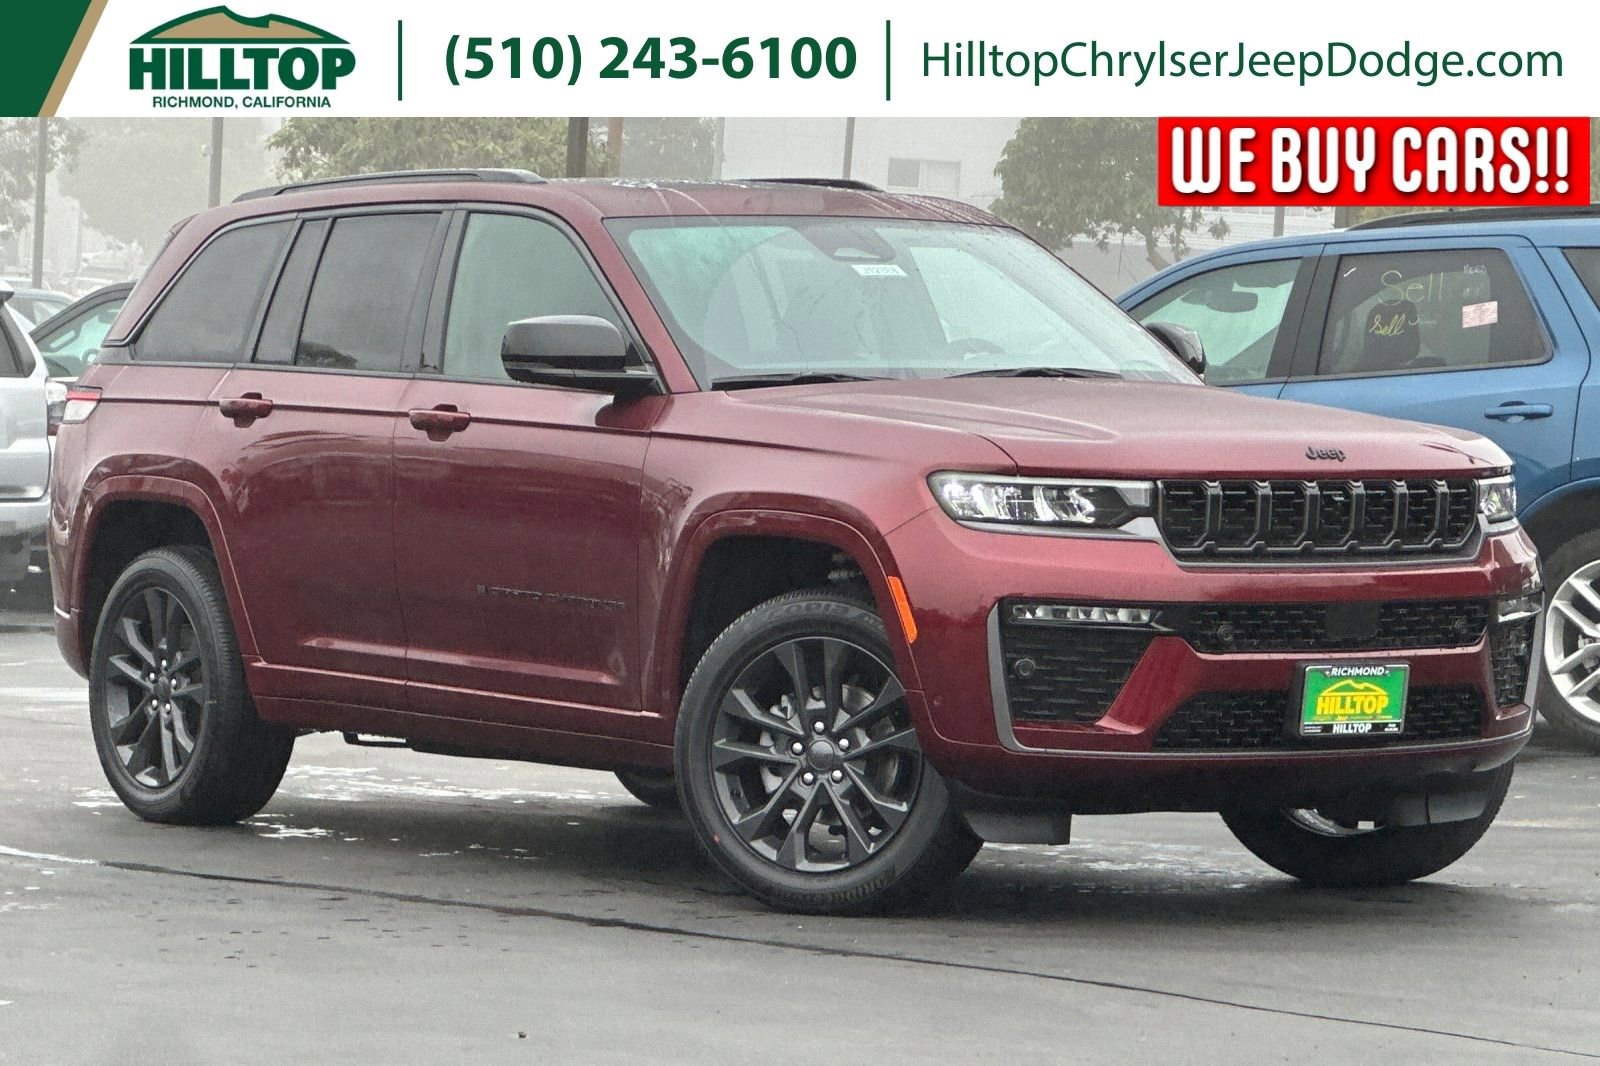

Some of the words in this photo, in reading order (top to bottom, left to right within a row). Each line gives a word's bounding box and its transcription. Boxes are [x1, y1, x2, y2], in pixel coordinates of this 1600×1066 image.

[1377, 270, 1444, 306] Sell
[1306, 446, 1346, 462] Jeep
[1331, 666, 1385, 676] RICHMOND
[1316, 695, 1389, 715] HILLTOP
[1332, 723, 1372, 734] HILLTOP
